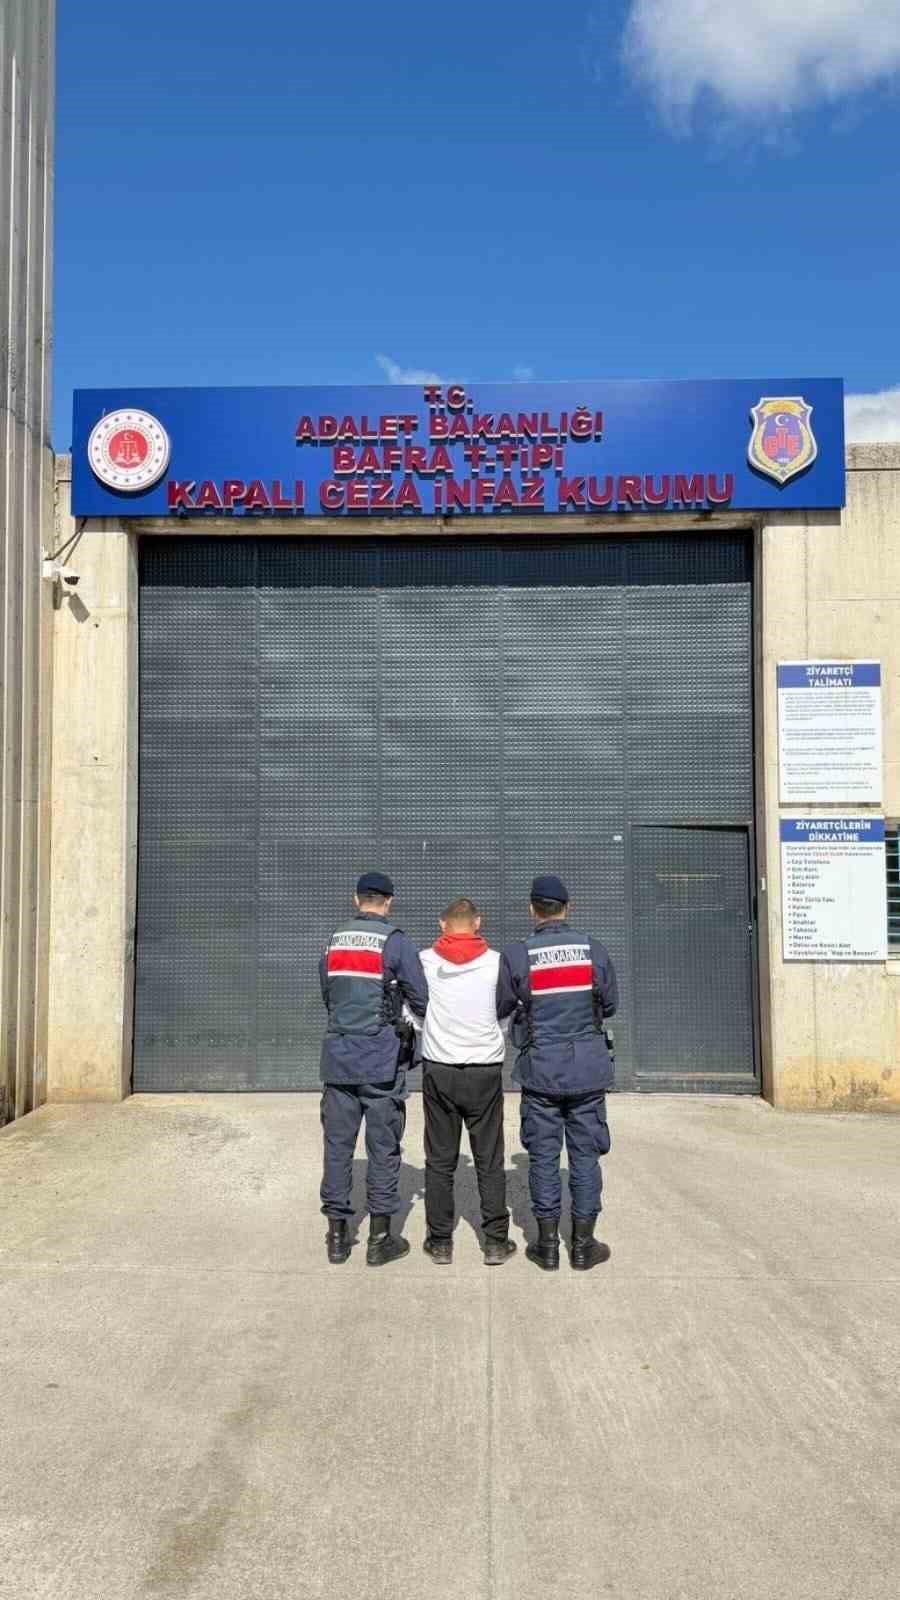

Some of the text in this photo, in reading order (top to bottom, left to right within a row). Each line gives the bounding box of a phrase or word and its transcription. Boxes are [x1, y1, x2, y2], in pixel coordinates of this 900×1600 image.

[424, 385, 473, 409] T.C.
[296, 407, 603, 440] ADALET BAKANLIĞI
[333, 446, 453, 474] BAFRA
[167, 474, 734, 508] KAPALI CEZA İNFAZ KURUMU
[805, 665, 853, 676] ZİYARETÇİ
[809, 677, 852, 687] TALİMATI
[795, 820, 871, 830] ZİYARETÇİLERİN
[808, 831, 859, 841] DİKKATİNE
